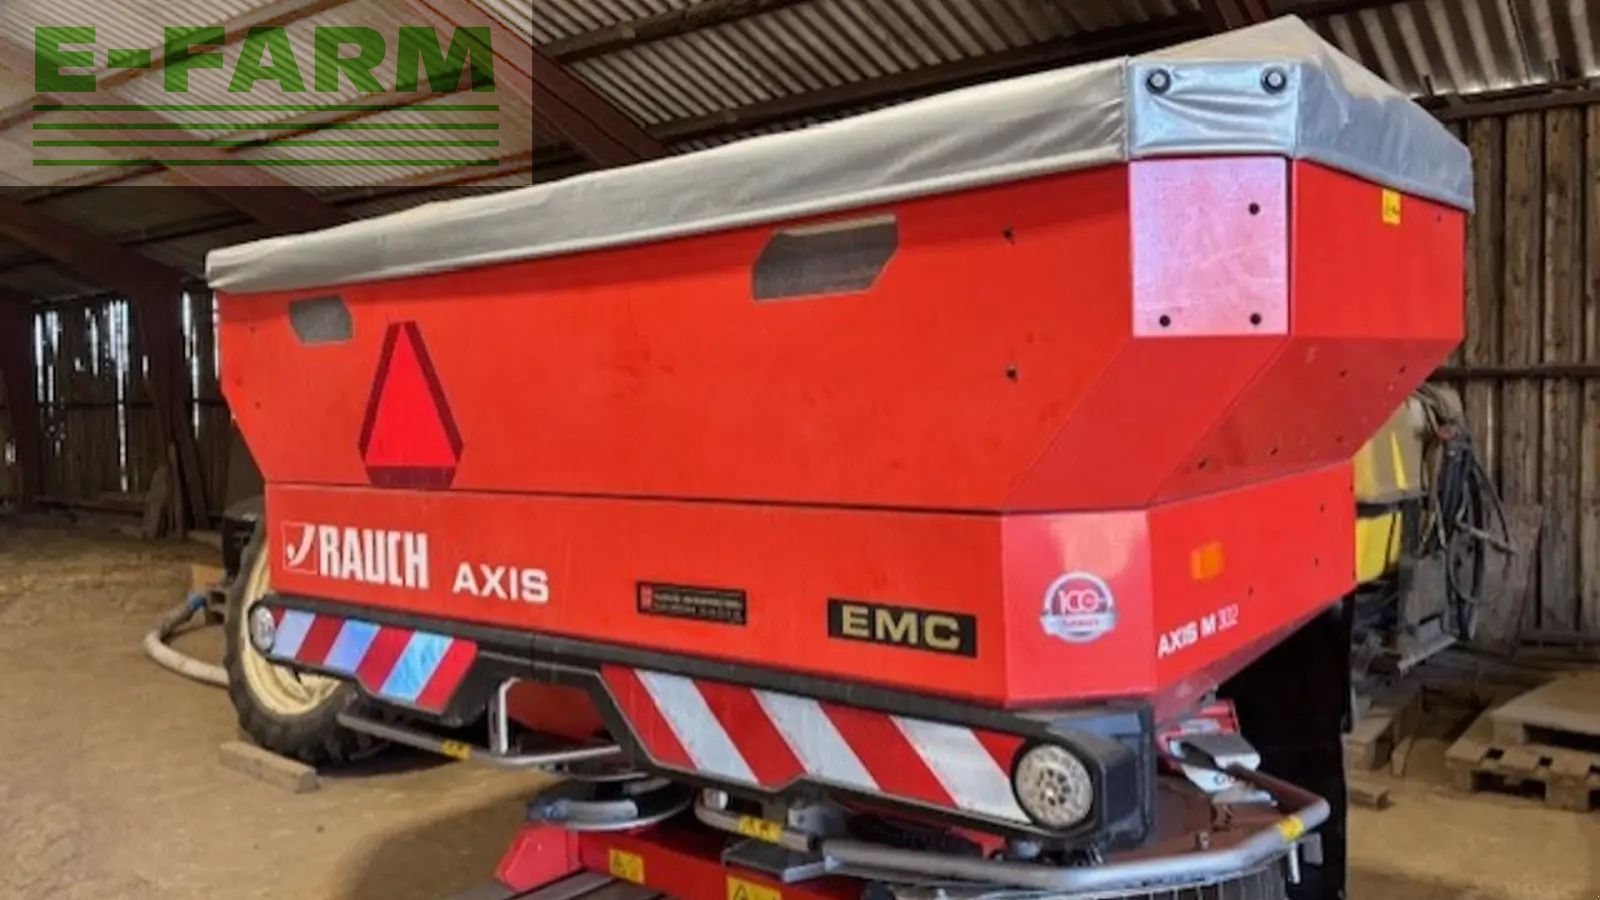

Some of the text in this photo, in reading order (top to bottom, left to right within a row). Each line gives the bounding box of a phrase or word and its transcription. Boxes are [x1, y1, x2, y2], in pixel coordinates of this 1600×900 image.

[318, 524, 550, 603] RAUCH AXIS
[841, 604, 961, 649] EMC
[1157, 603, 1240, 659] AXIS M 302
